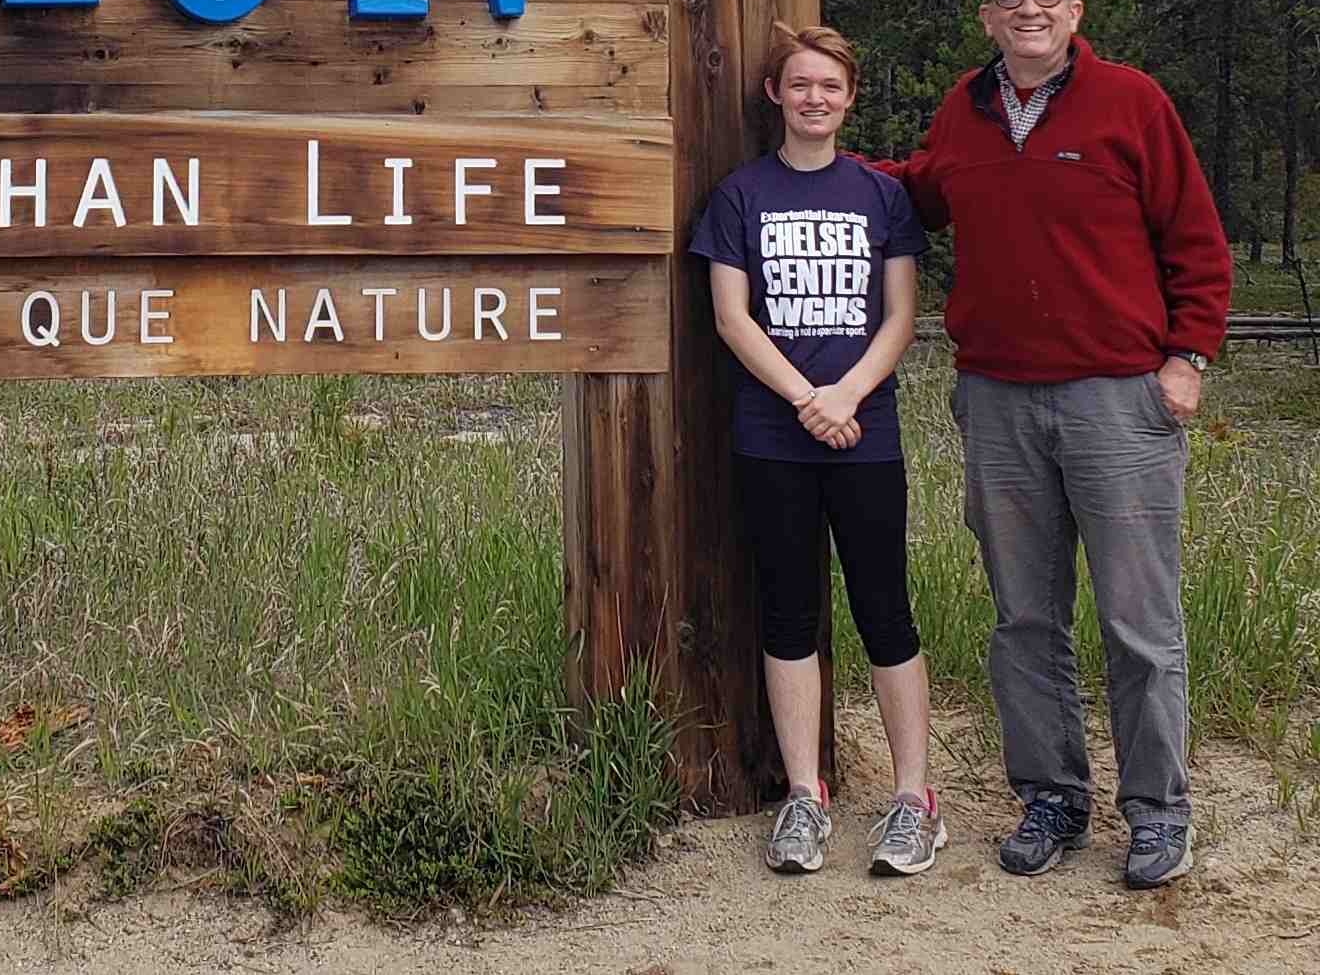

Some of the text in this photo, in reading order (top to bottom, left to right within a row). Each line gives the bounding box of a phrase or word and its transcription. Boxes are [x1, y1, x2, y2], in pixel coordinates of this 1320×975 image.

[307, 139, 567, 226] LIFE
[761, 222, 872, 259] CHELSEA
[762, 258, 871, 296] CENTER
[21, 289, 175, 348] QUE
[249, 286, 563, 343] NATURE
[765, 296, 868, 327] WGHS
[817, 326, 845, 338] speor
